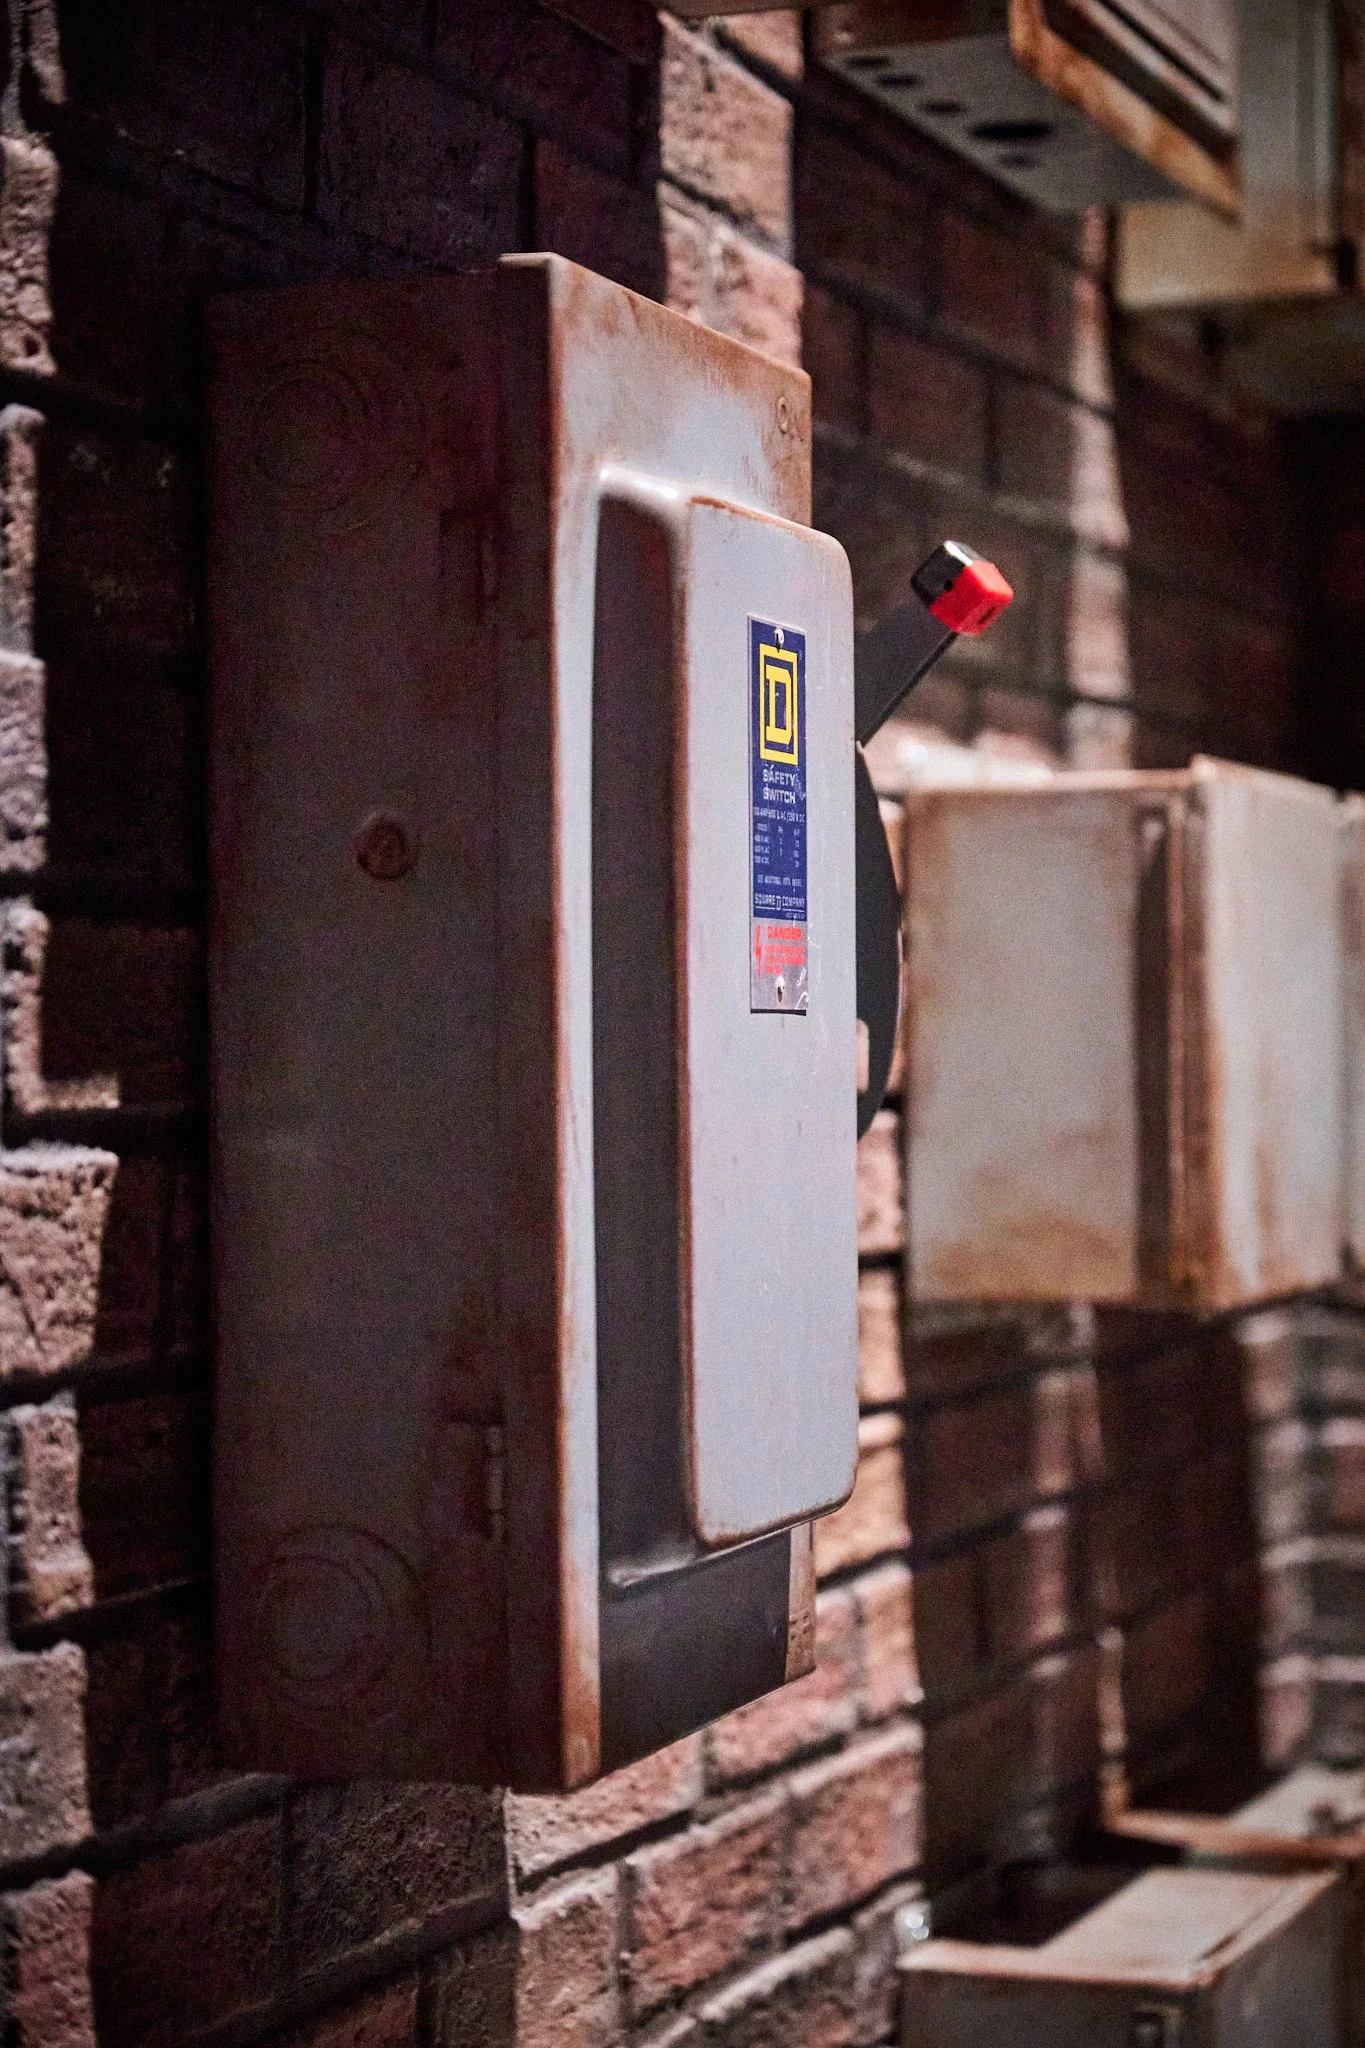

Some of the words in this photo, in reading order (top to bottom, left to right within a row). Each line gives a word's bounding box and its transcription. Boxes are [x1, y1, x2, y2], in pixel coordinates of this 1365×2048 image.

[762, 768, 796, 786] SAFETY
[762, 786, 796, 804] SWITCH
[755, 893, 776, 906] SQUARE
[782, 895, 805, 908] COMPANY
